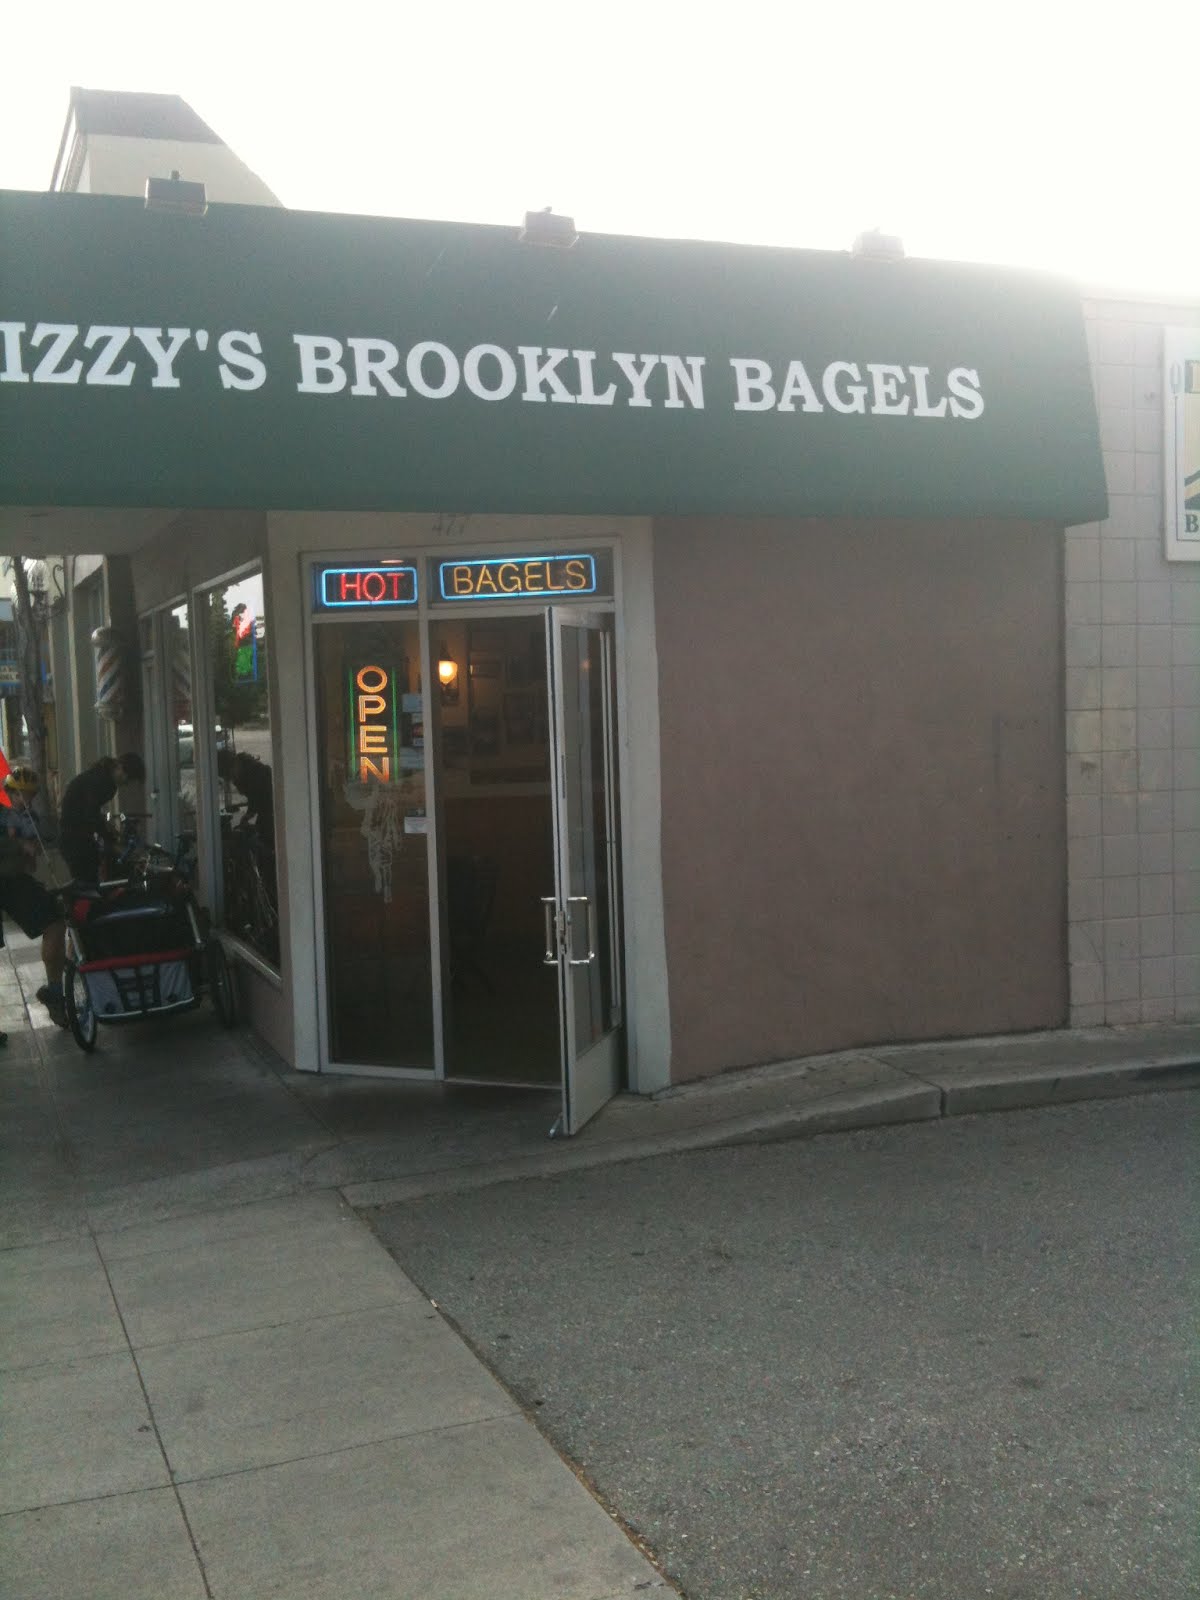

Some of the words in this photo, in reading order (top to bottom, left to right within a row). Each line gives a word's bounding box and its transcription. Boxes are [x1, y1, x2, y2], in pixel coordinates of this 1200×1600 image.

[0, 321, 267, 391] IZZY'S
[293, 334, 706, 409] BROOKLYN
[729, 358, 985, 419] BAGELS
[340, 571, 405, 601] HOT
[452, 560, 588, 595] BAGELS
[356, 664, 390, 785] OPEN
